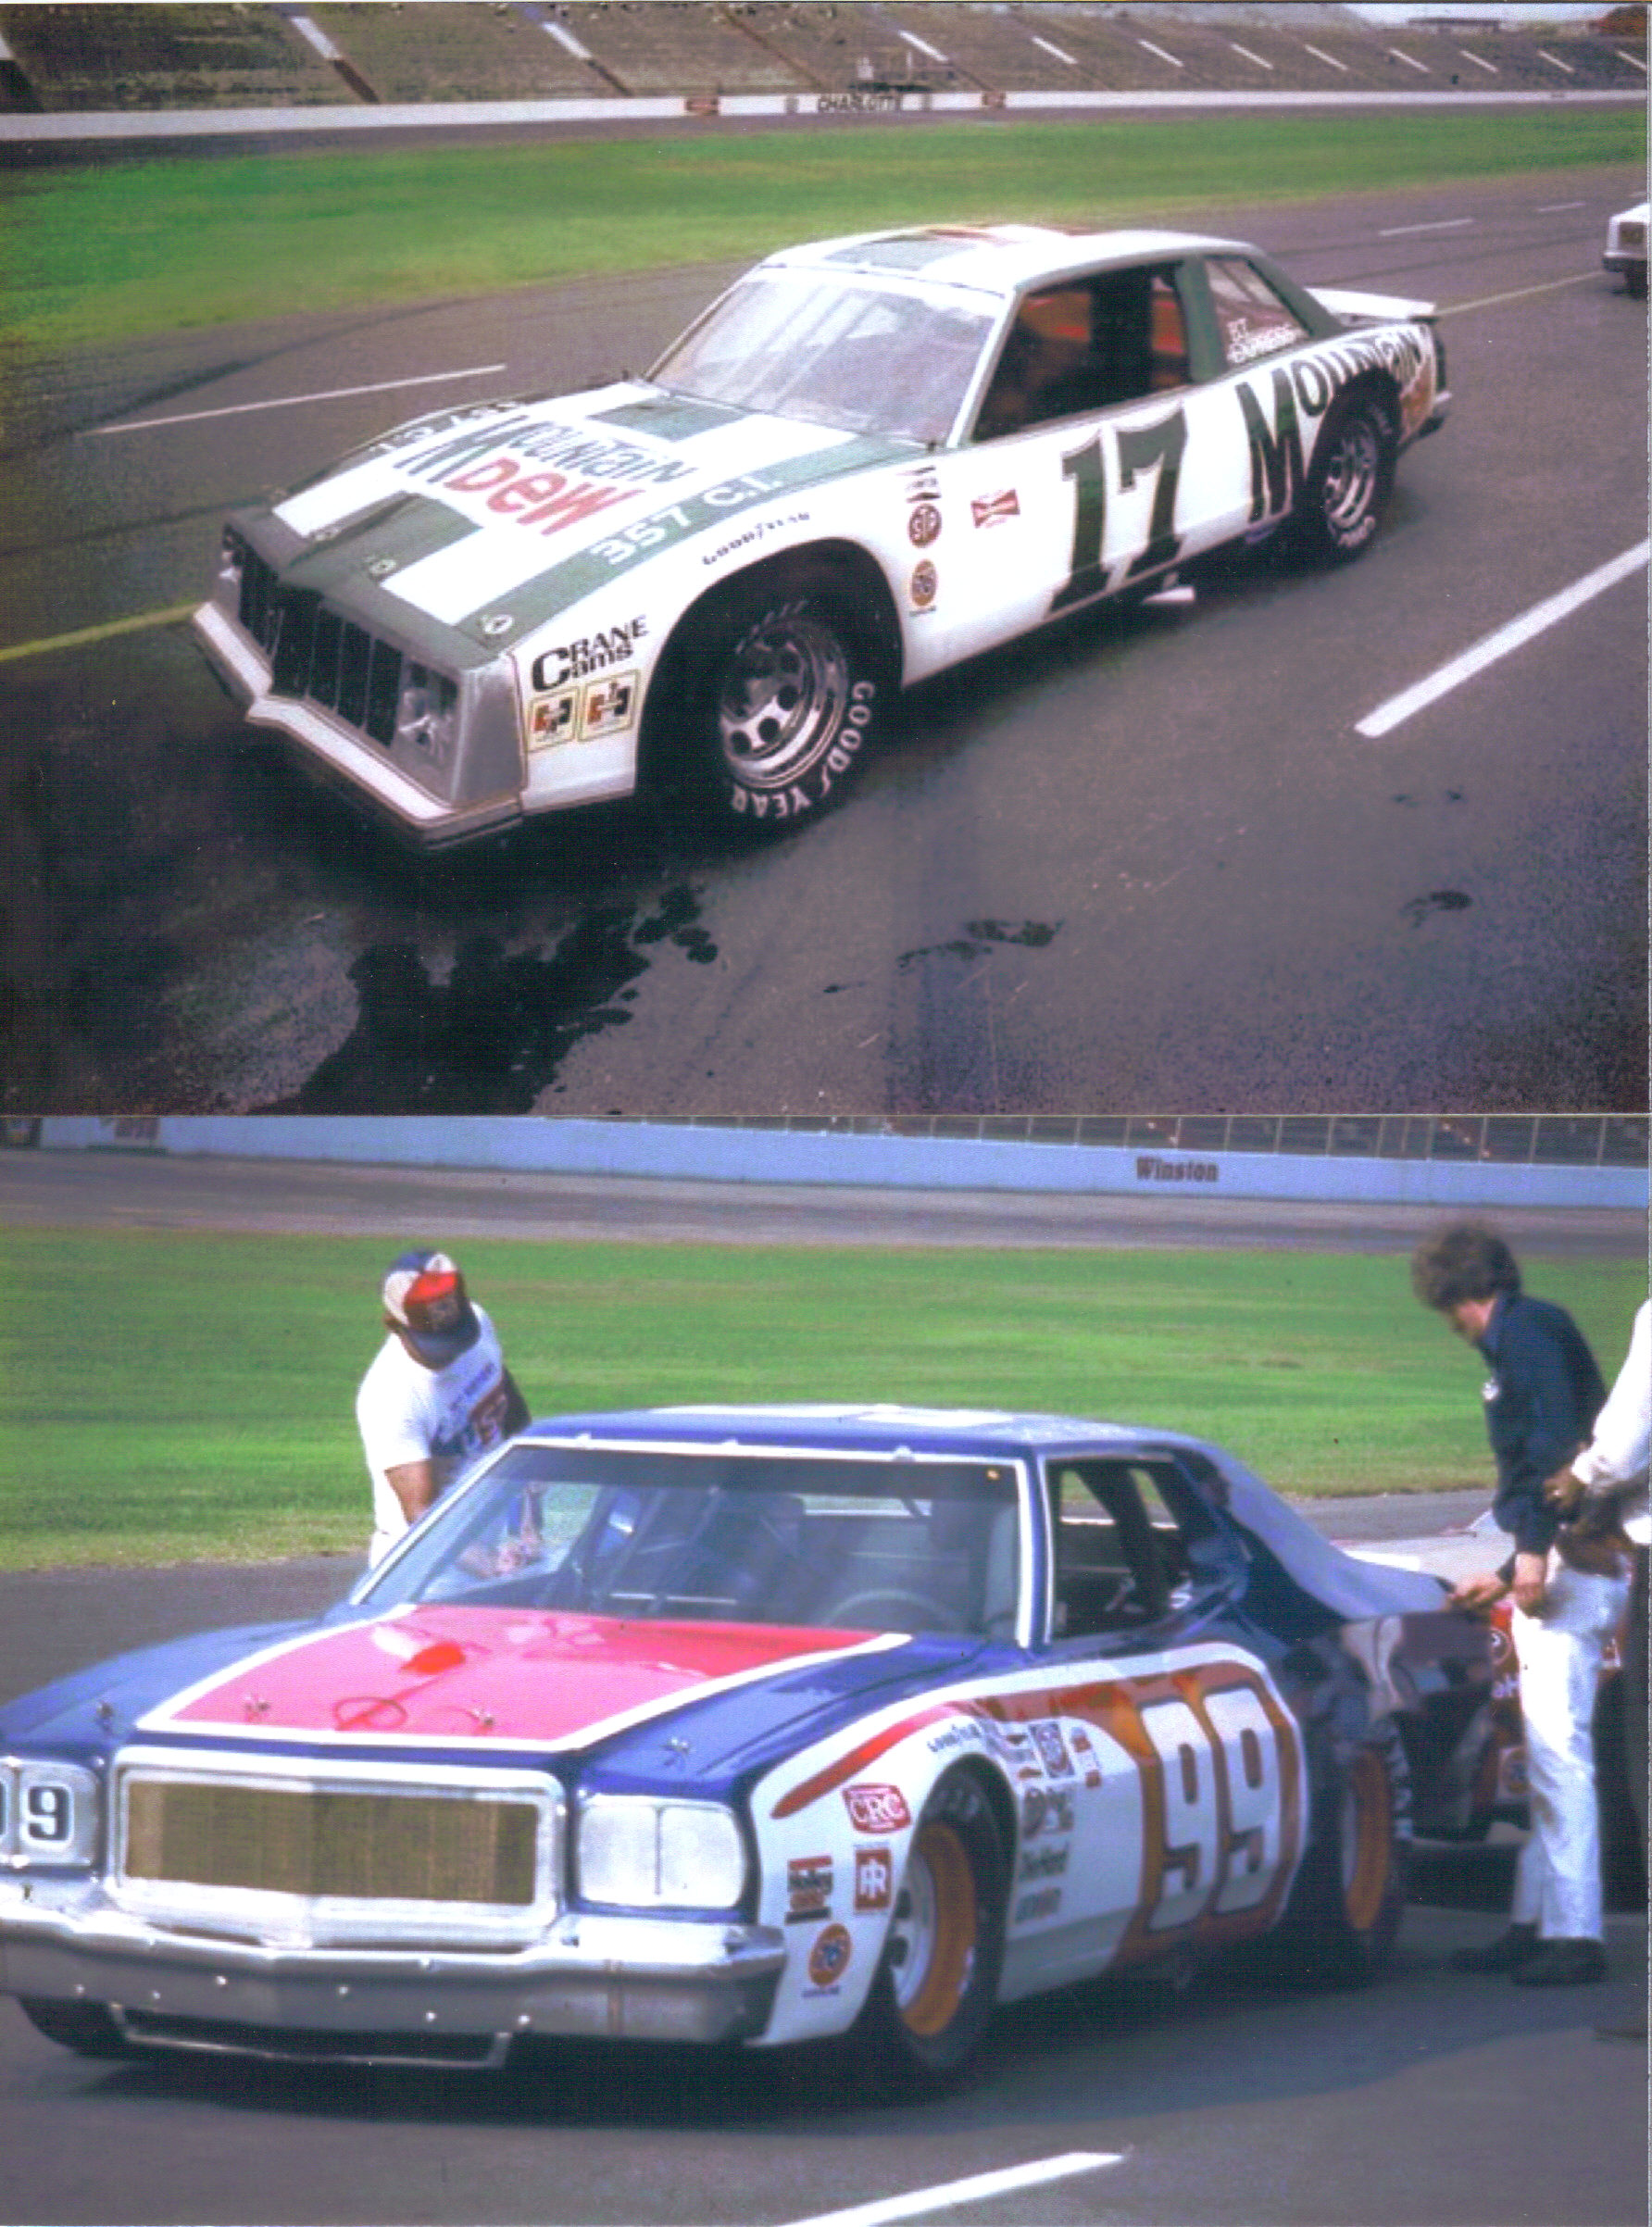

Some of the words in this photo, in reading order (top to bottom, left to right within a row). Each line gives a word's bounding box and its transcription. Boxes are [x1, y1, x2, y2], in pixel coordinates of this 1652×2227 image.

[590, 506, 693, 566] 357
[1048, 404, 1187, 615] 17
[532, 615, 649, 693] CRANE
[1136, 1156, 1220, 1182] Winston
[850, 1791, 908, 1823] CRC
[1142, 1685, 1283, 1931] 99
